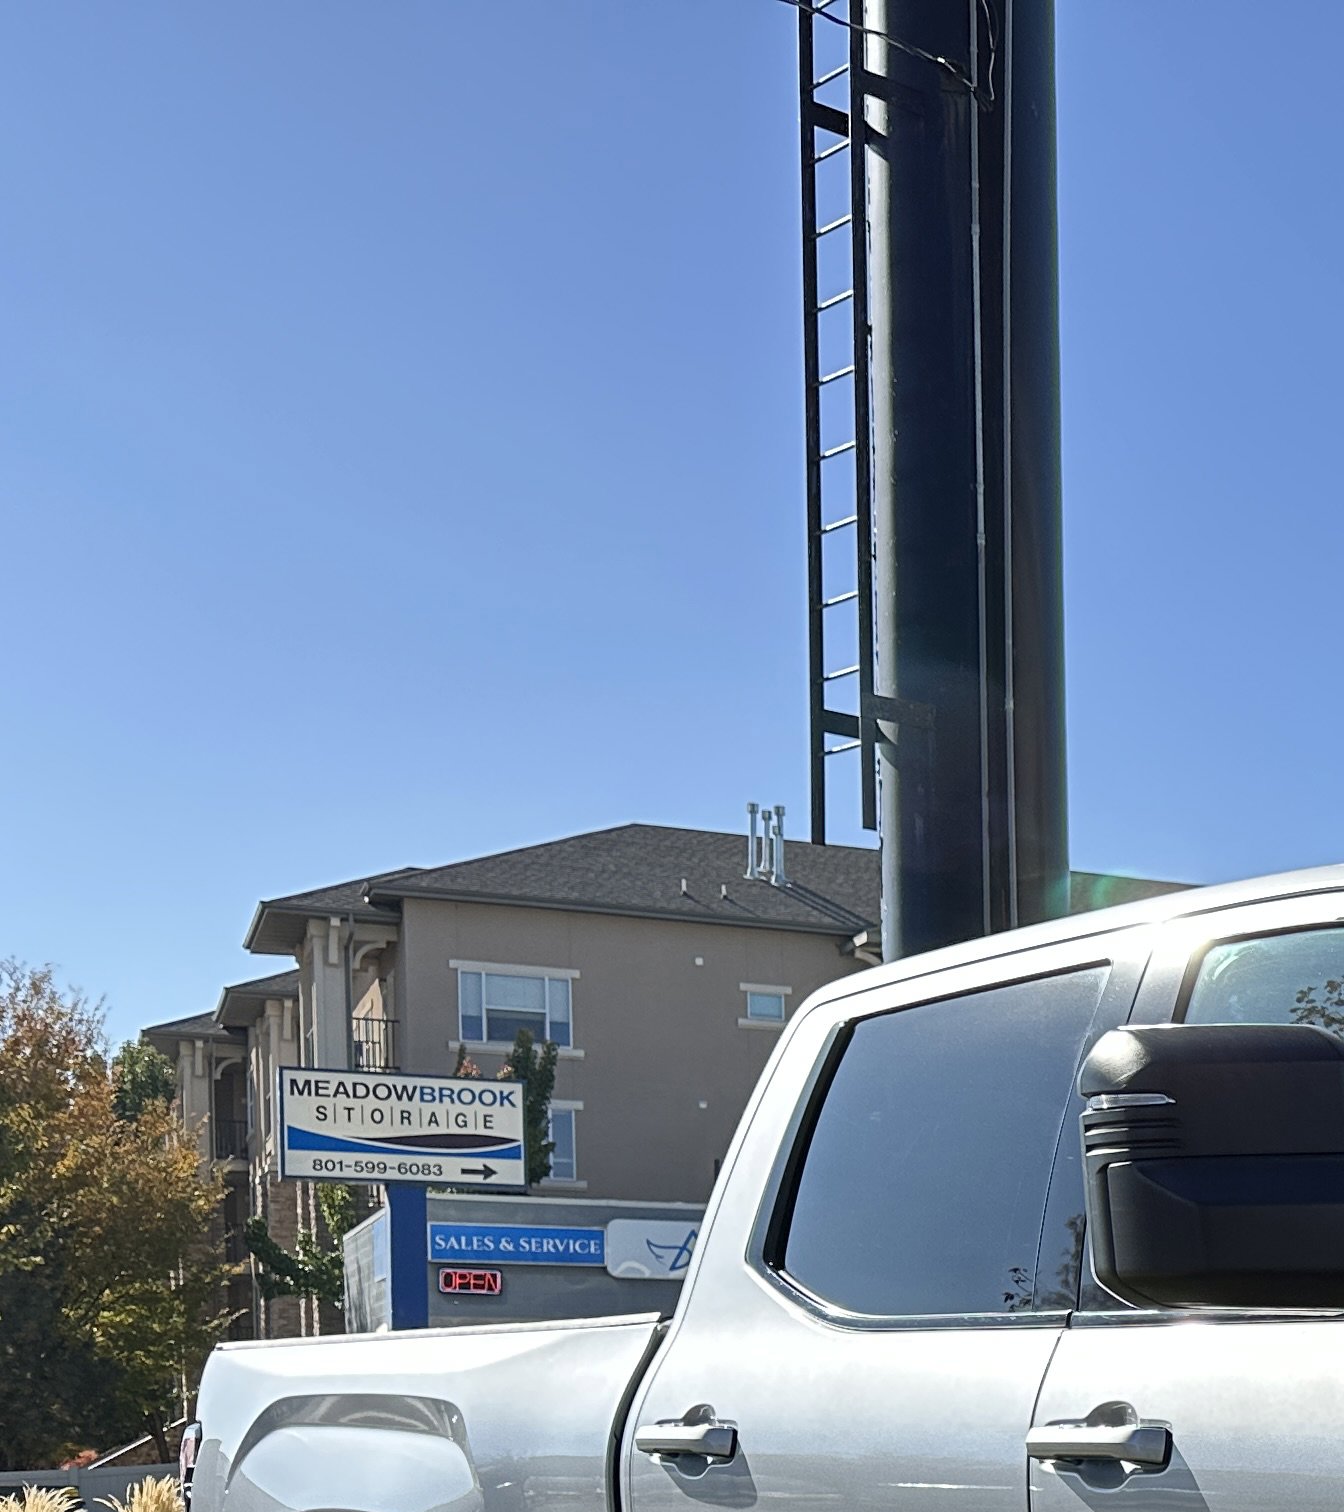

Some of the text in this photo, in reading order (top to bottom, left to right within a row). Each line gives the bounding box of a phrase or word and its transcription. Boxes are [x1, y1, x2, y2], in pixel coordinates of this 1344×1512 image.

[288, 1078, 517, 1108] MEADOWBROOK
[311, 1158, 443, 1177] 801-599-6083
[434, 1234, 601, 1255] SALES & SERVICE
[442, 1271, 499, 1292] OPEN
